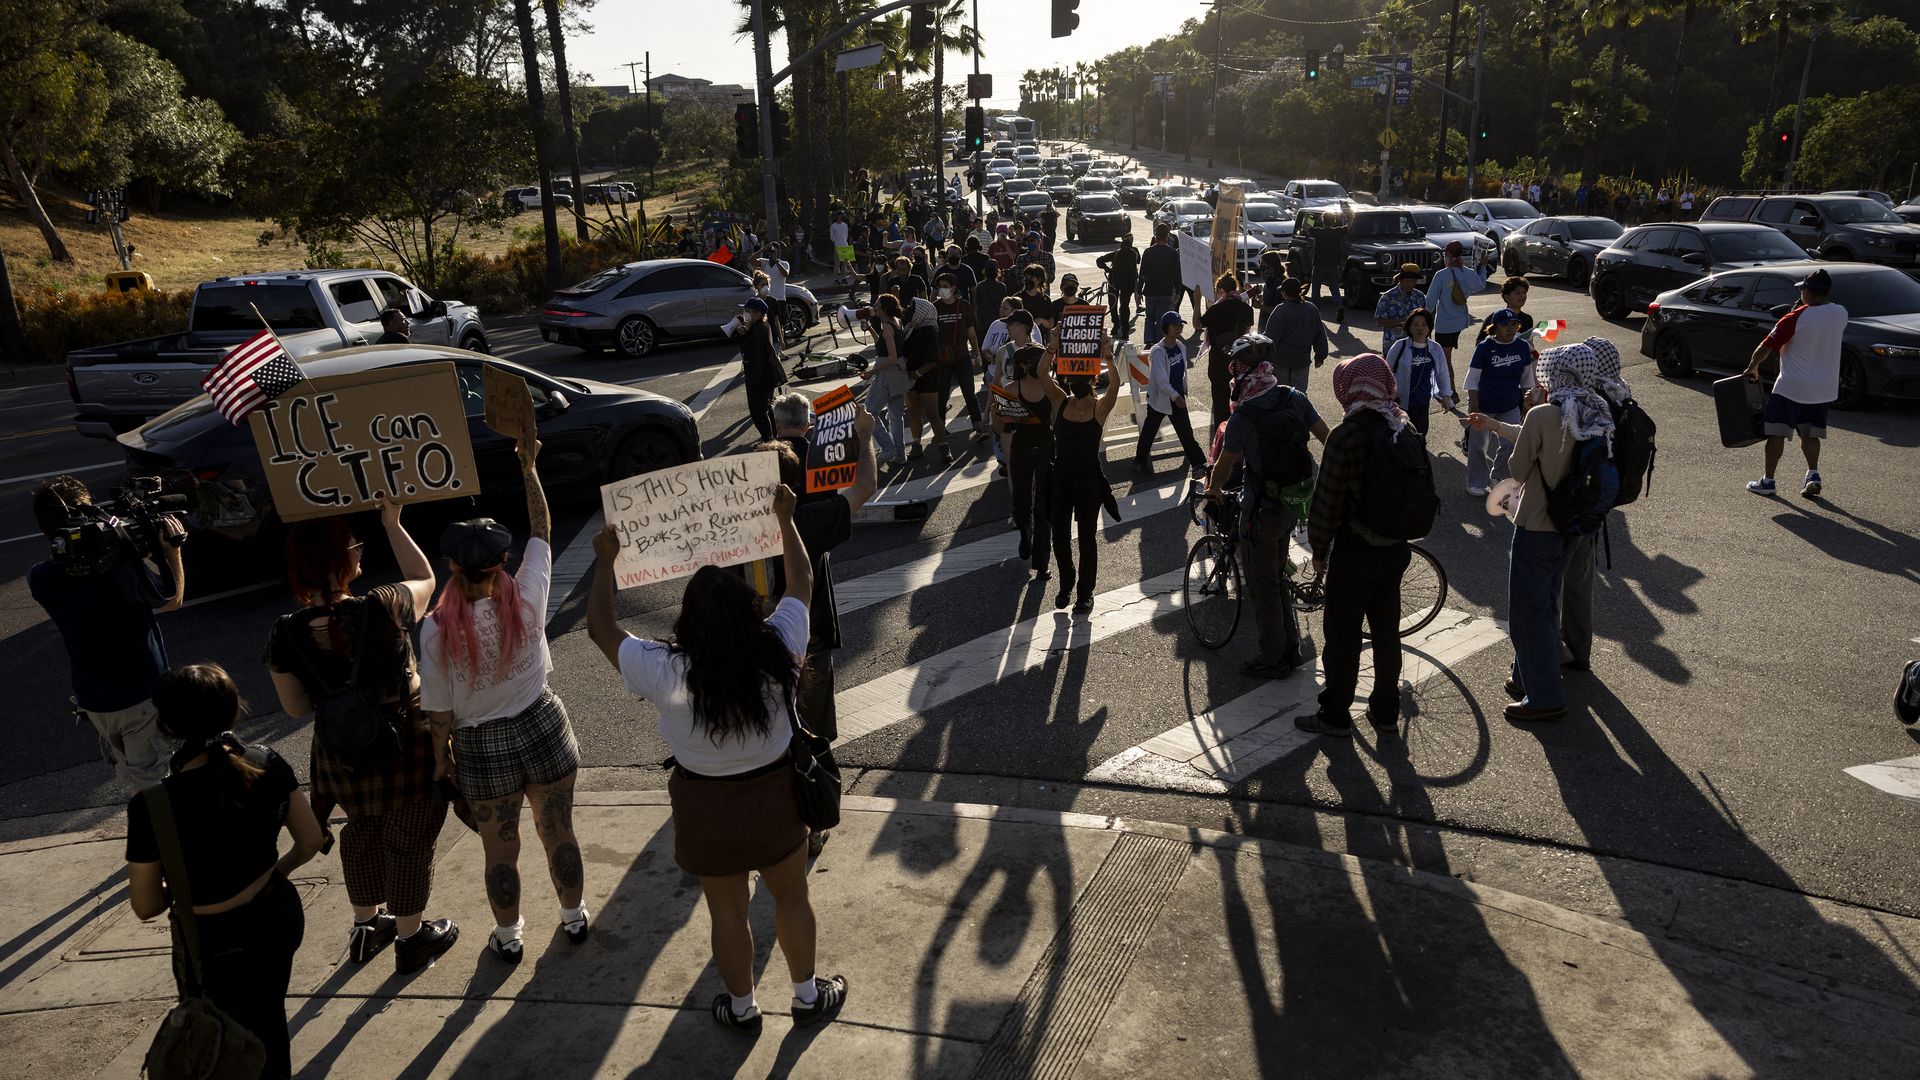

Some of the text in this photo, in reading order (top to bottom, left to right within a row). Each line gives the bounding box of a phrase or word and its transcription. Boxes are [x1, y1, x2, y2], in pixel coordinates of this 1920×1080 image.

[1063, 315, 1103, 328] ¡QUE SE
[1060, 328, 1101, 340] LARGUE
[1061, 342, 1099, 354] TRUMP
[1491, 353, 1521, 367] Dodgers
[817, 401, 856, 430] TRUMP
[254, 393, 441, 464] I.C.E. can
[816, 421, 854, 446] MUST
[824, 442, 846, 463] GO
[296, 441, 461, 506] G.T.F.O.
[814, 465, 856, 488] NOW
[610, 461, 748, 511] IS THIS HOW
[659, 498, 712, 523] WANT
[724, 483, 777, 506] HISTOR
[620, 569, 651, 585] VIVA
[653, 566, 668, 579] LA
[671, 561, 698, 573] RAZA
